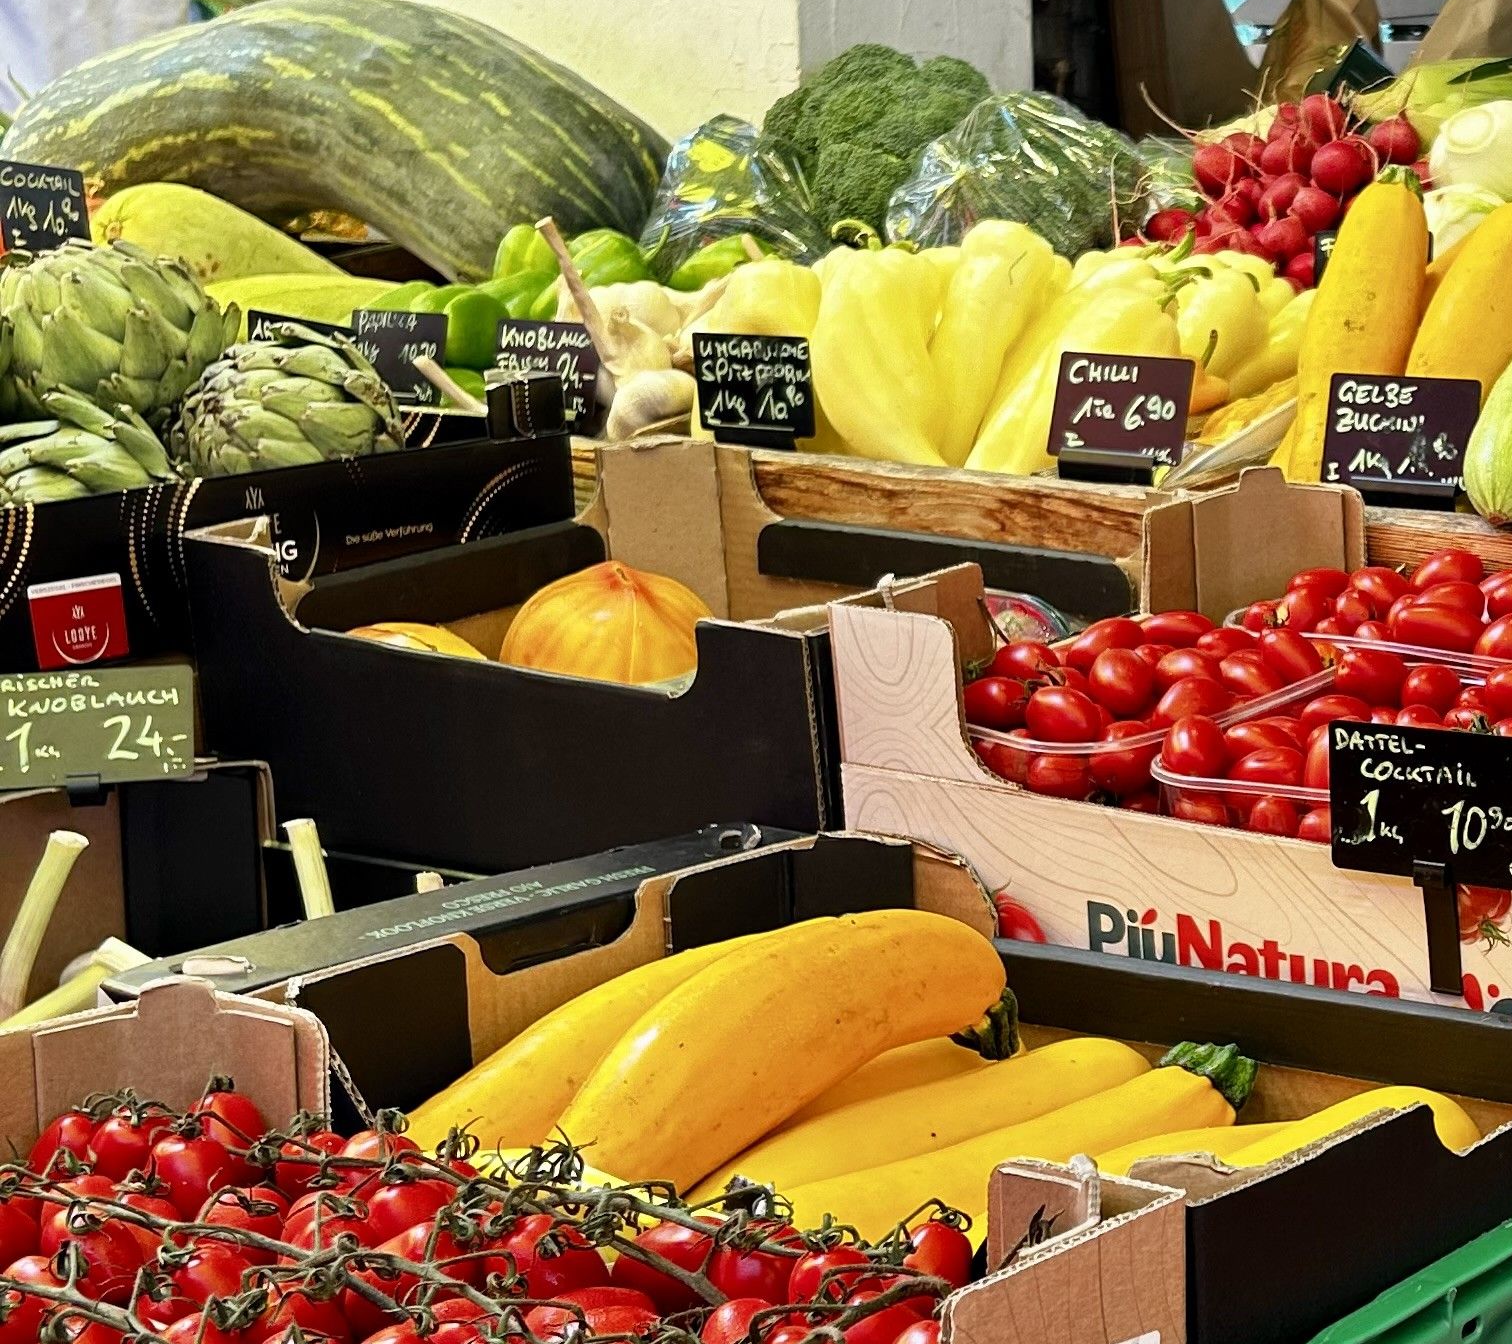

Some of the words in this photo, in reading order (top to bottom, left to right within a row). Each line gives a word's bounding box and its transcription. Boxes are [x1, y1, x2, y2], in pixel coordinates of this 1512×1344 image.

[1069, 359, 1138, 384] CHILLI
[1337, 380, 1418, 408] GELBE
[64, 624, 98, 646] LOOYE
[0, 673, 100, 693] RISCHER
[7, 687, 179, 717] KNOBLAUCH
[1334, 727, 1426, 755] DATTEL-
[1360, 757, 1477, 788] COCKTAIL
